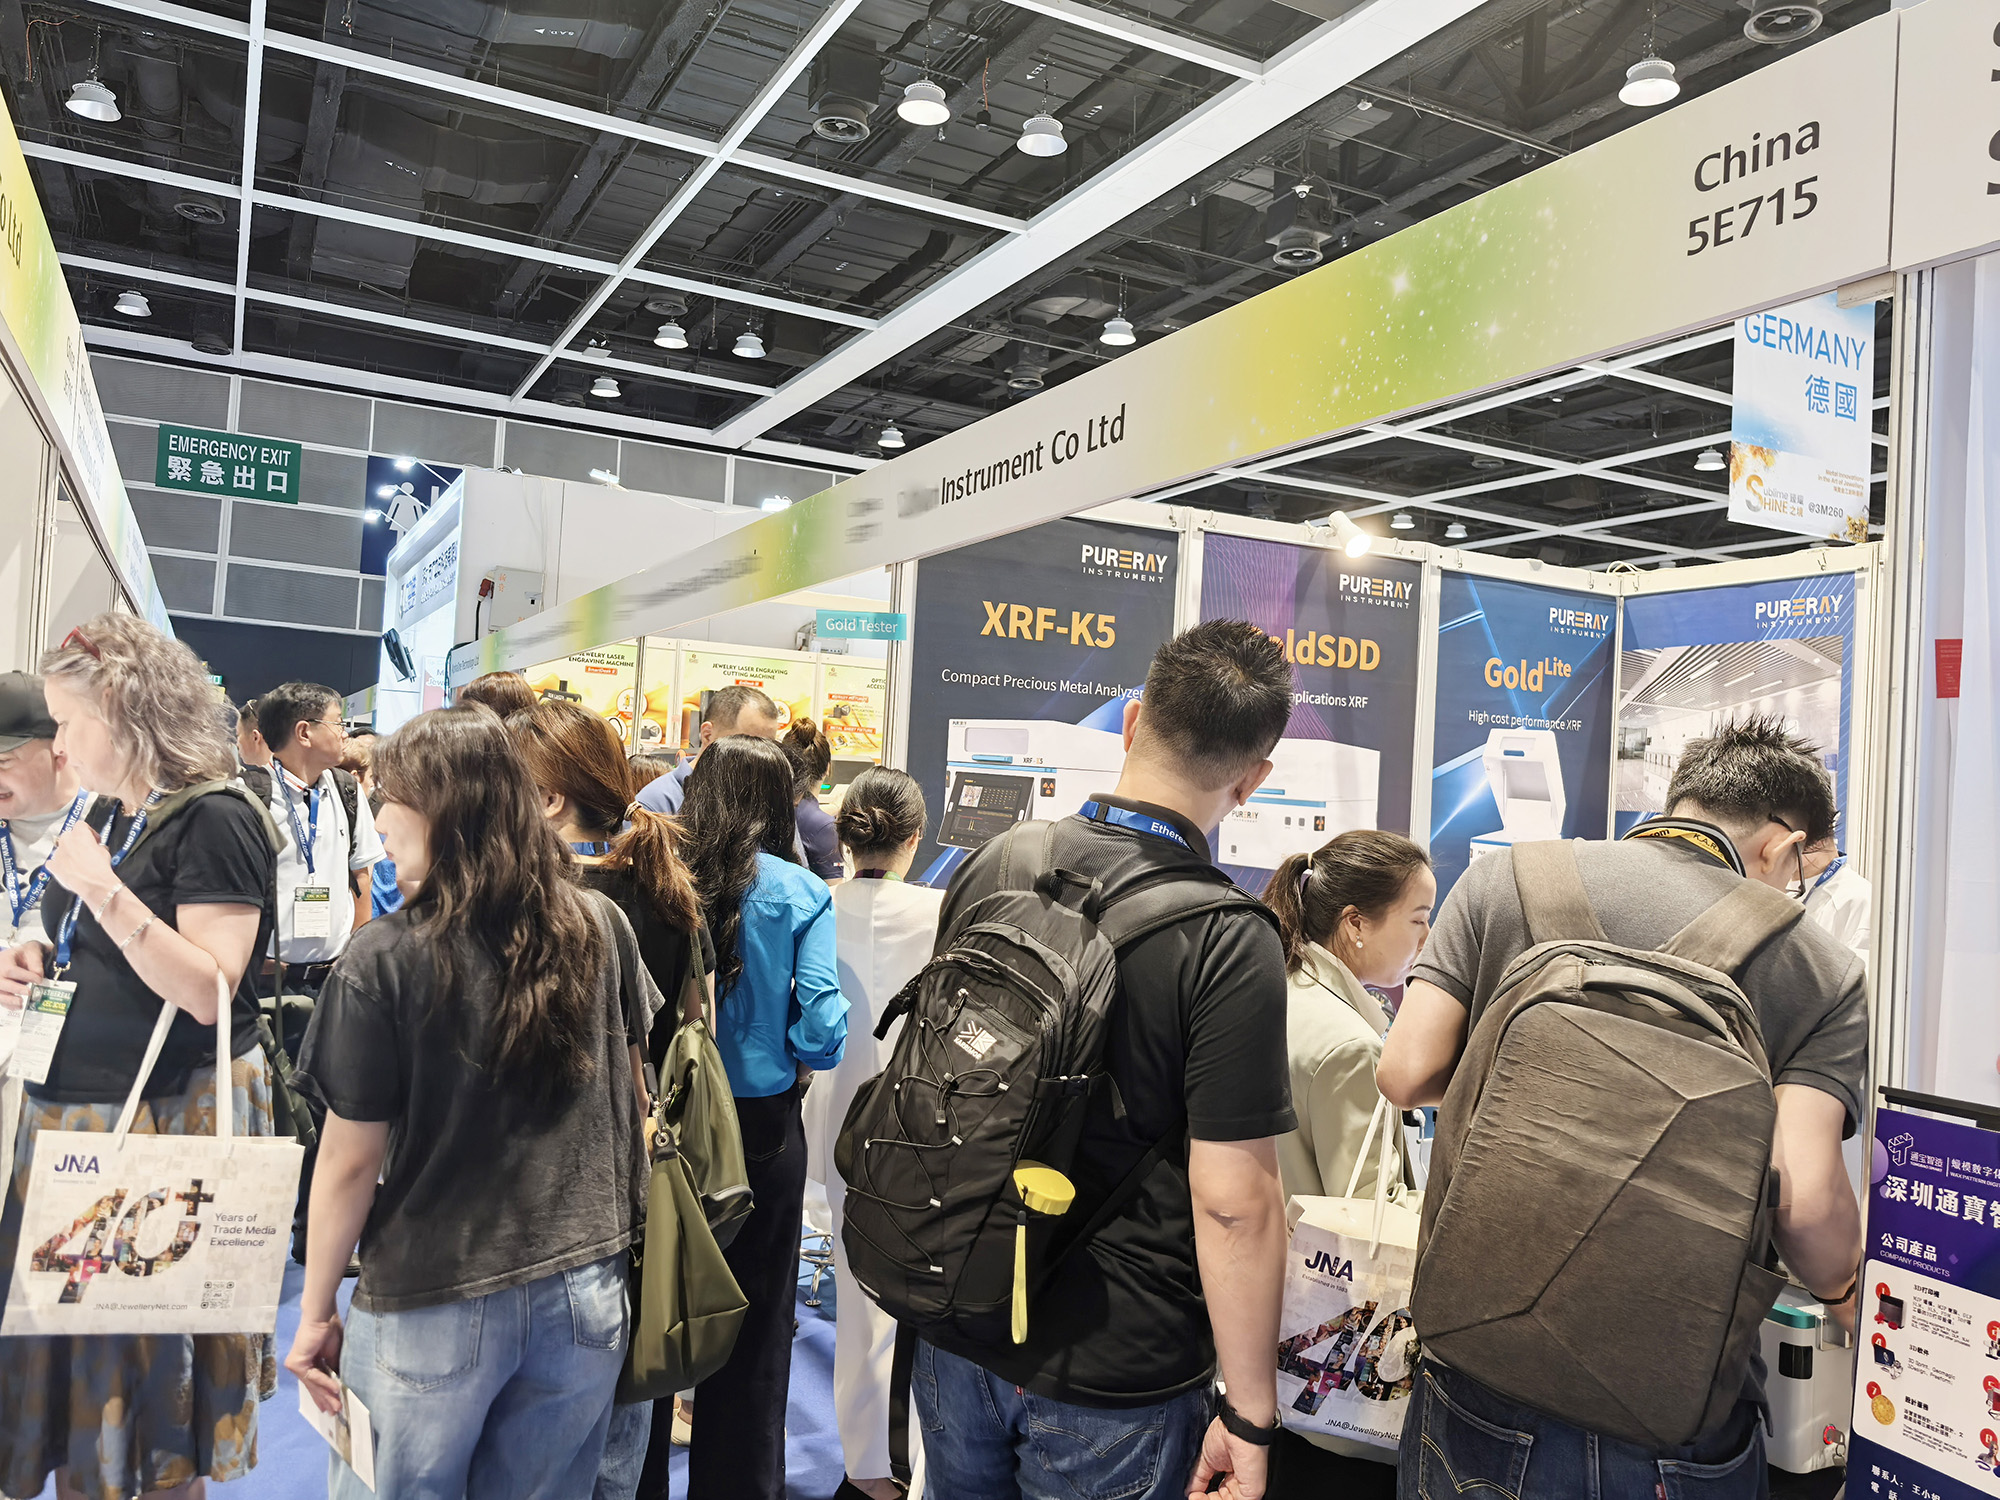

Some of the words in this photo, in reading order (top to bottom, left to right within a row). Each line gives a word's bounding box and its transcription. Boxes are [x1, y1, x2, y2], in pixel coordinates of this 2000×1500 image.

[1694, 120, 1820, 193] China
[1686, 175, 1819, 256] 5E715
[8, 200, 22, 269] Ltd
[1743, 313, 1866, 371] GERMANY
[1805, 374, 1858, 423] 德國
[169, 434, 258, 462] EMERGENCY
[261, 447, 292, 467] EXIT
[941, 441, 1043, 506] Instrument
[1051, 430, 1080, 465] Co
[1087, 403, 1126, 453] Ltd
[167, 455, 288, 494] 緊急出口
[1808, 501, 1844, 518] @3M260
[1082, 544, 1168, 574] PURERAY
[1083, 567, 1164, 584] INSTRUMENT
[1339, 573, 1413, 600] PURERAY
[1341, 595, 1410, 610] INSTRUMENT
[1755, 594, 1843, 620] PURERAY
[825, 618, 857, 632] Gold
[859, 619, 898, 633] Tester
[980, 600, 1116, 650] XRF-K5
[1549, 607, 1609, 631] PURERAY
[1756, 615, 1840, 629] INSTRUMENT
[1550, 626, 1606, 640] INSTRUMENT
[1251, 626, 1381, 671] ldSDD
[755, 667, 788, 675] ENGRAVING
[941, 668, 1001, 692] Compact
[1003, 674, 1057, 692] Precious
[1059, 678, 1092, 695] Metal
[1484, 657, 1544, 692] Gold
[1545, 657, 1572, 678] Lite
[1290, 690, 1347, 707] plications
[1348, 695, 1369, 709] XRF
[1468, 709, 1489, 726] High
[1490, 714, 1509, 725] cost
[1511, 715, 1565, 731] performance
[1566, 719, 1582, 731] XRF
[62, 797, 85, 834] star.com
[54, 1154, 100, 1173] JNA
[212, 1225, 243, 1234] Trade
[244, 1226, 277, 1235] Media
[215, 1213, 244, 1222] Years
[246, 1213, 258, 1222] of
[210, 1237, 265, 1247] Excellence
[1881, 1233, 1937, 1262] 公司產品
[1305, 1250, 1354, 1282] JNA
[1880, 1250, 1913, 1265] COMPANY
[1912, 1260, 1951, 1278] PRODUCTS
[93, 1302, 188, 1311] JNA@JewelleryNet.com
